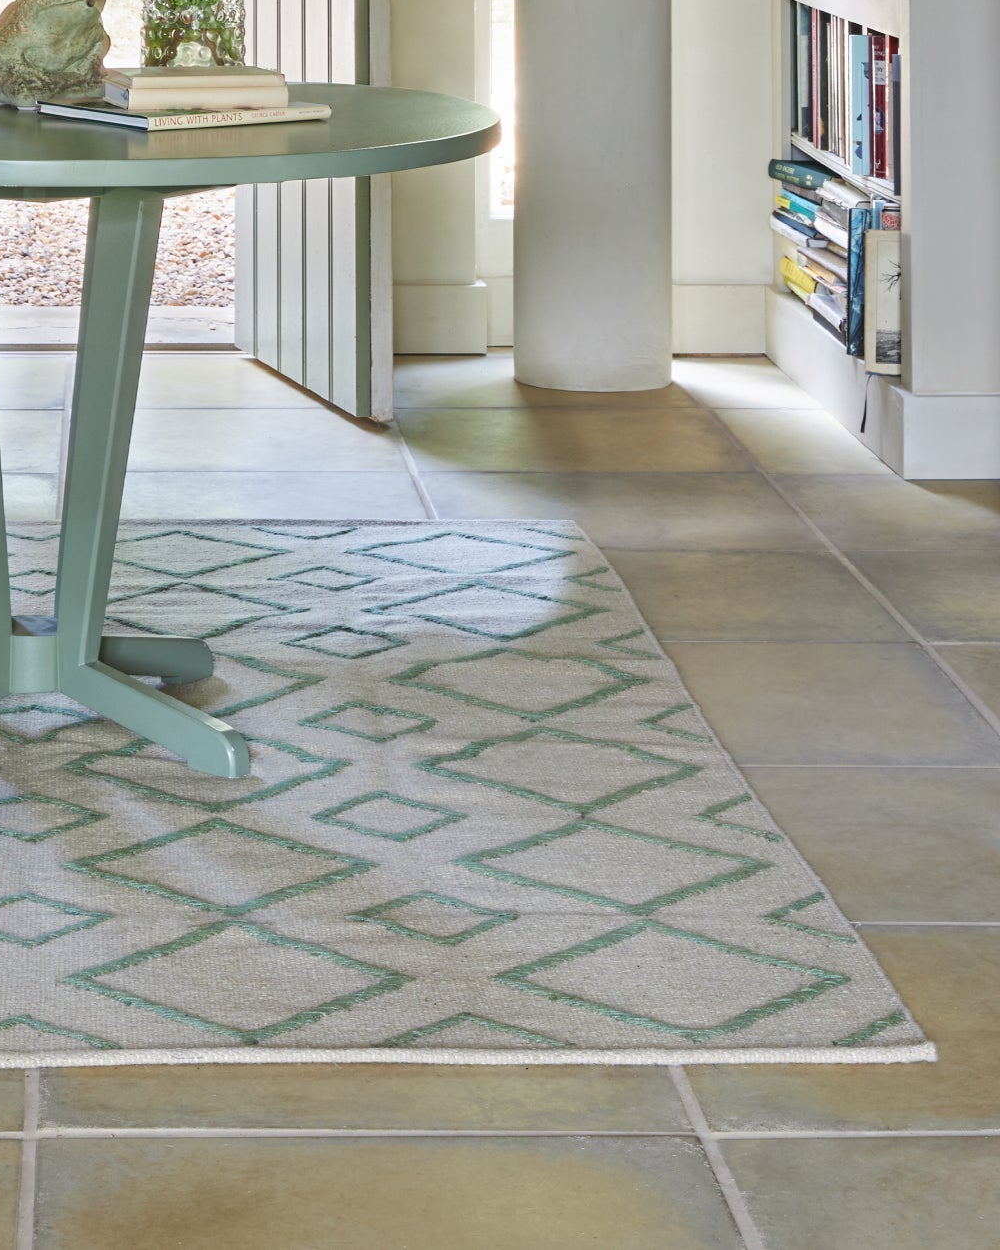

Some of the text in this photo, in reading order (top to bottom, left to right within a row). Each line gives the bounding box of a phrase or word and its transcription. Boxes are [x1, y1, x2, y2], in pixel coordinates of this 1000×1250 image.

[154, 113, 243, 127] LIVING WITH PLANTS
